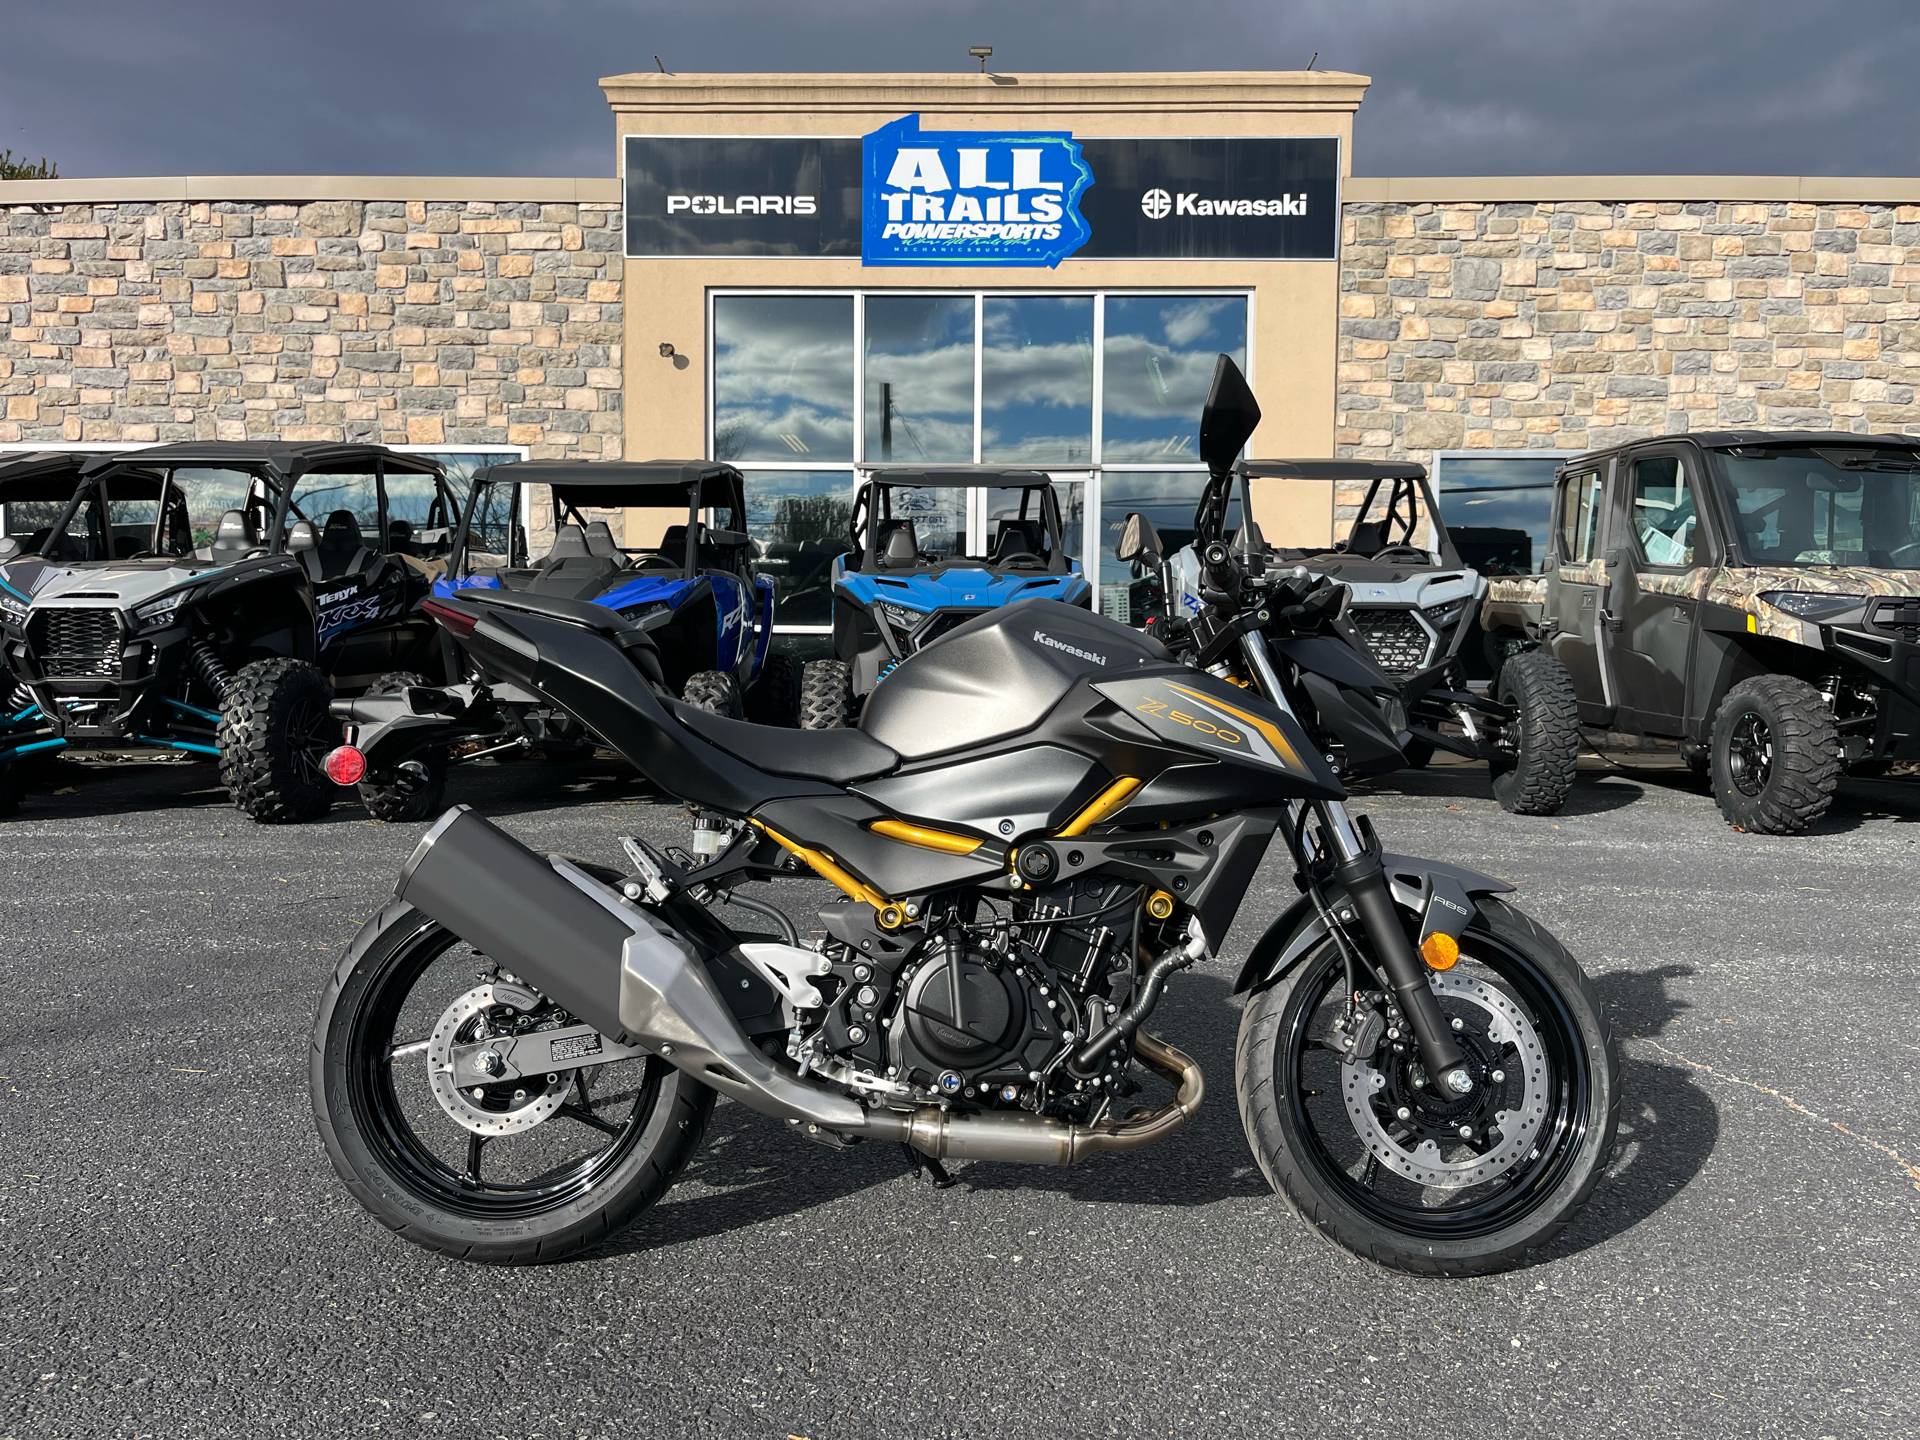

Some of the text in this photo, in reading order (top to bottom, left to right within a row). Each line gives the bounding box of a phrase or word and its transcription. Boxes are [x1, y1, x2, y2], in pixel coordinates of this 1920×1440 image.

[886, 148, 1063, 193] ALL
[666, 195, 817, 215] POLARIS
[881, 192, 1063, 222] TRAILS
[1176, 193, 1308, 216] Kawasaki
[881, 223, 1062, 240] POWERSPORTS
[1499, 590, 1532, 599] RANGER
[1033, 630, 1107, 667] Kawasaki
[1168, 710, 1241, 744] 500
[1433, 895, 1468, 916] ABS
[362, 1166, 425, 1218] DUNLOP
